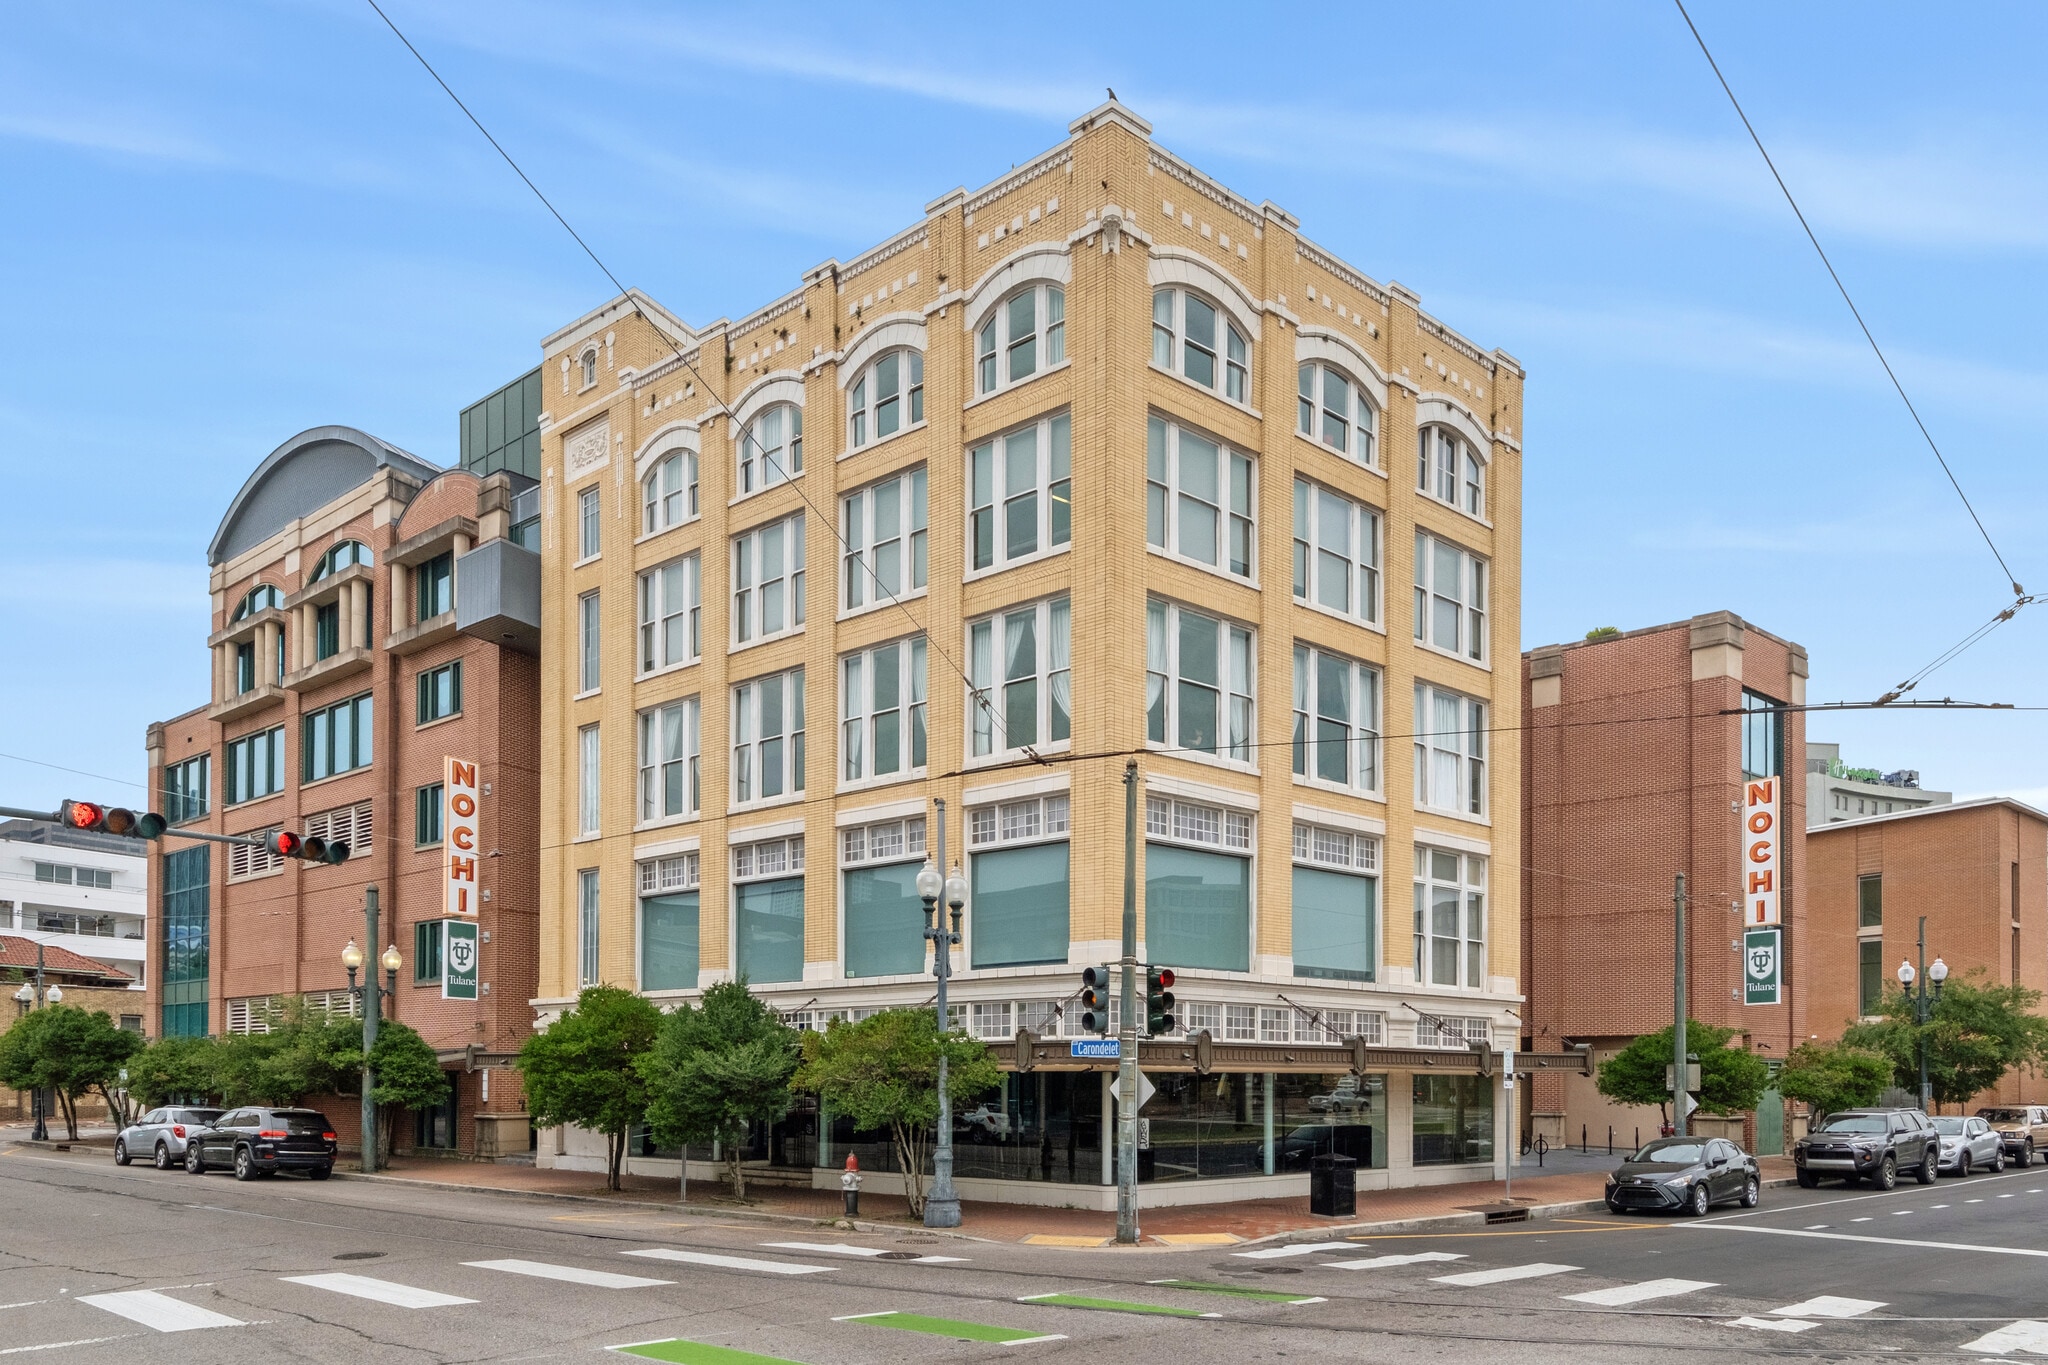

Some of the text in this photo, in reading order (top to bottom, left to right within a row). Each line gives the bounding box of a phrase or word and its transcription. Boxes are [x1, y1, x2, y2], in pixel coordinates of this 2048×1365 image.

[451, 760, 476, 913] NOCHI
[1747, 780, 1773, 923] NOCHI
[448, 975, 476, 986] Tulane
[1746, 982, 1776, 992] Tulane
[1077, 1041, 1119, 1055] Carondelet
